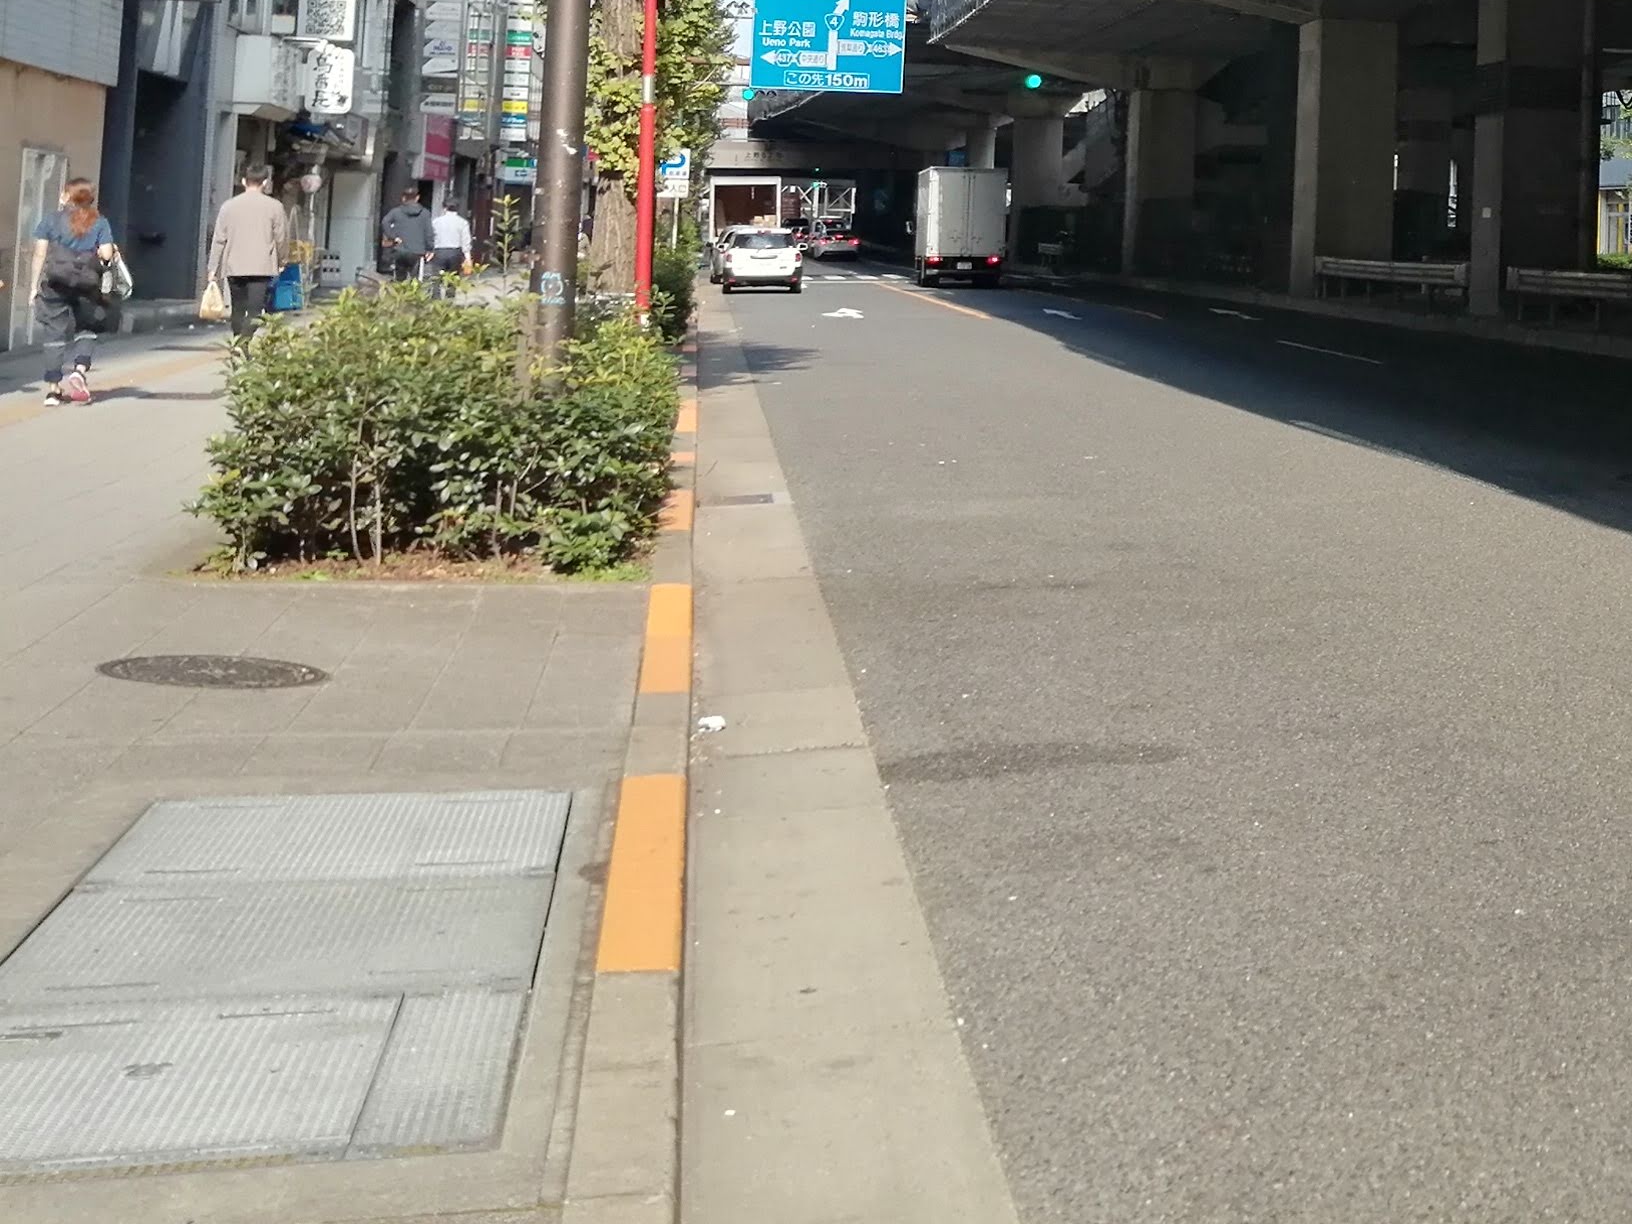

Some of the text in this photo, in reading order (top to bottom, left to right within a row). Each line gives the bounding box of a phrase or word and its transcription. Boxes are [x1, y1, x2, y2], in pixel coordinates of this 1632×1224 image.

[829, 17, 839, 27] 4
[852, 11, 900, 28] 駒形橋
[759, 20, 816, 37] 上野公園
[762, 37, 811, 48] Ueno Park
[669, 184, 687, 193] 入口
